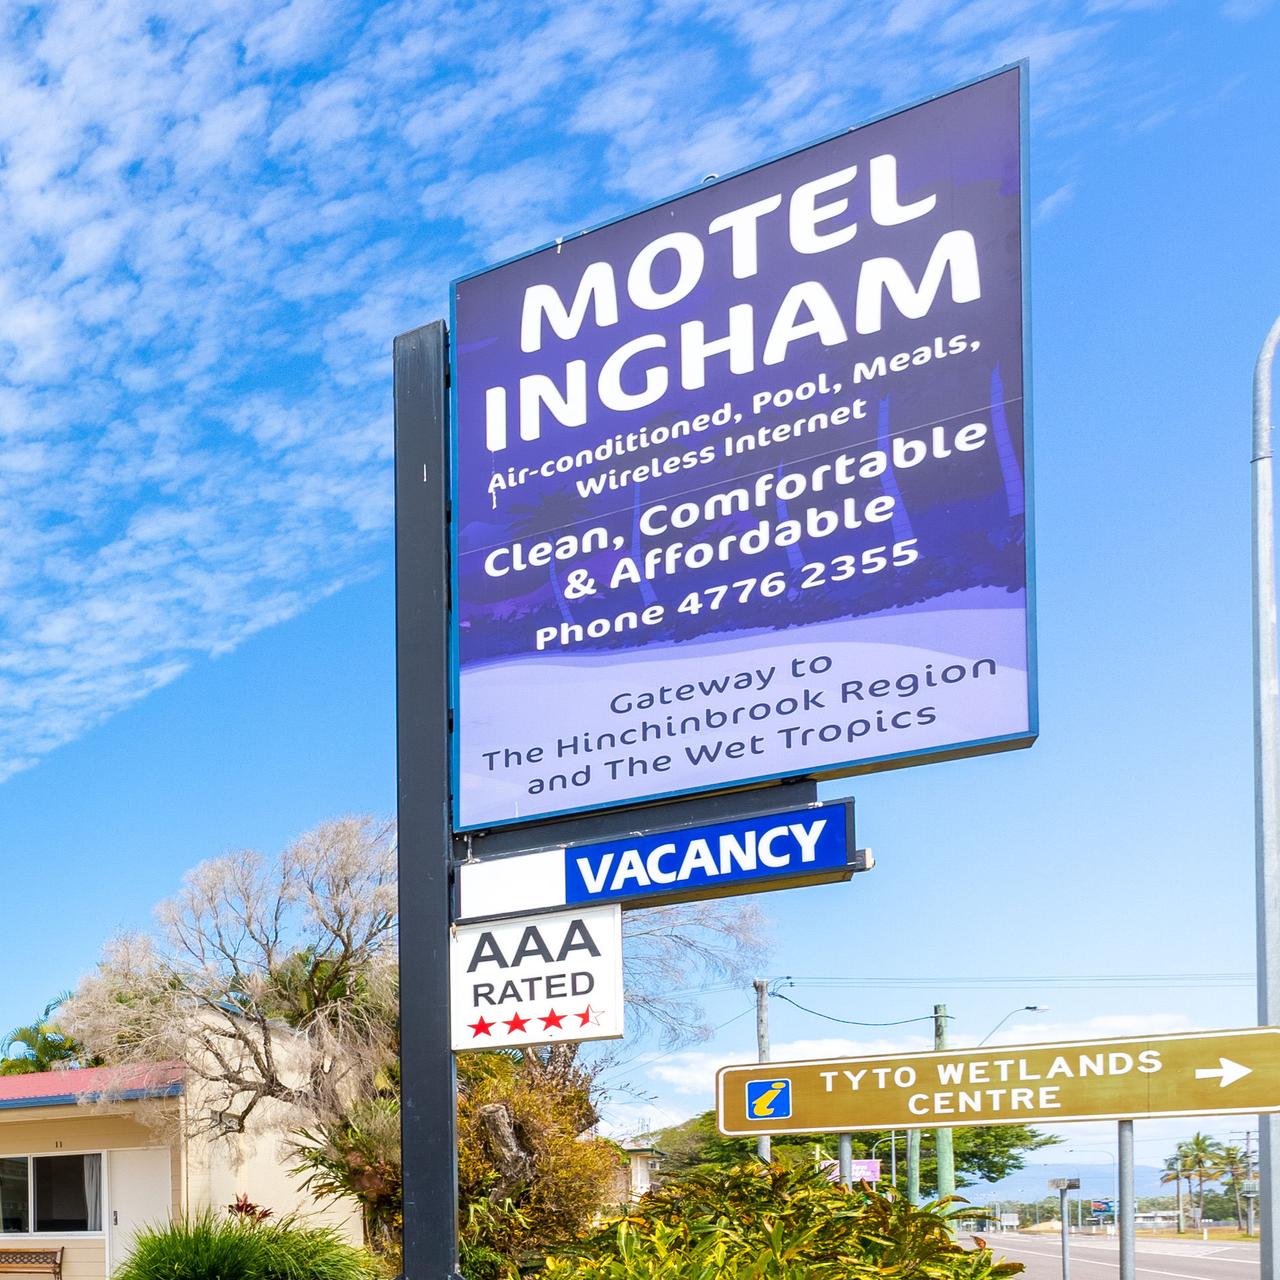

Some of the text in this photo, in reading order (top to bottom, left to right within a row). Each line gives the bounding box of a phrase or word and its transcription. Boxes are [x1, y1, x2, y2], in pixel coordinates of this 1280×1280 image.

[520, 153, 937, 353] MOTEL
[485, 229, 981, 453] INGHAM
[487, 334, 981, 496] Air-conditioned, Pool, Meals,
[575, 398, 867, 498] Wireless Internet
[484, 422, 988, 577] Clean, Comfortable
[563, 495, 896, 600] & Affordable
[536, 538, 919, 651] Phone 4776 2355
[482, 658, 996, 771] The Hinchinbrook Region
[610, 655, 833, 714] Gateway to
[528, 706, 936, 795] and The Wet Tropics
[576, 819, 827, 894] VACANCY
[466, 918, 601, 973] AAA
[473, 971, 595, 1007] RATED
[819, 1049, 1163, 1092] TYTO WETLANDS
[907, 1085, 1062, 1116] CENTRE
